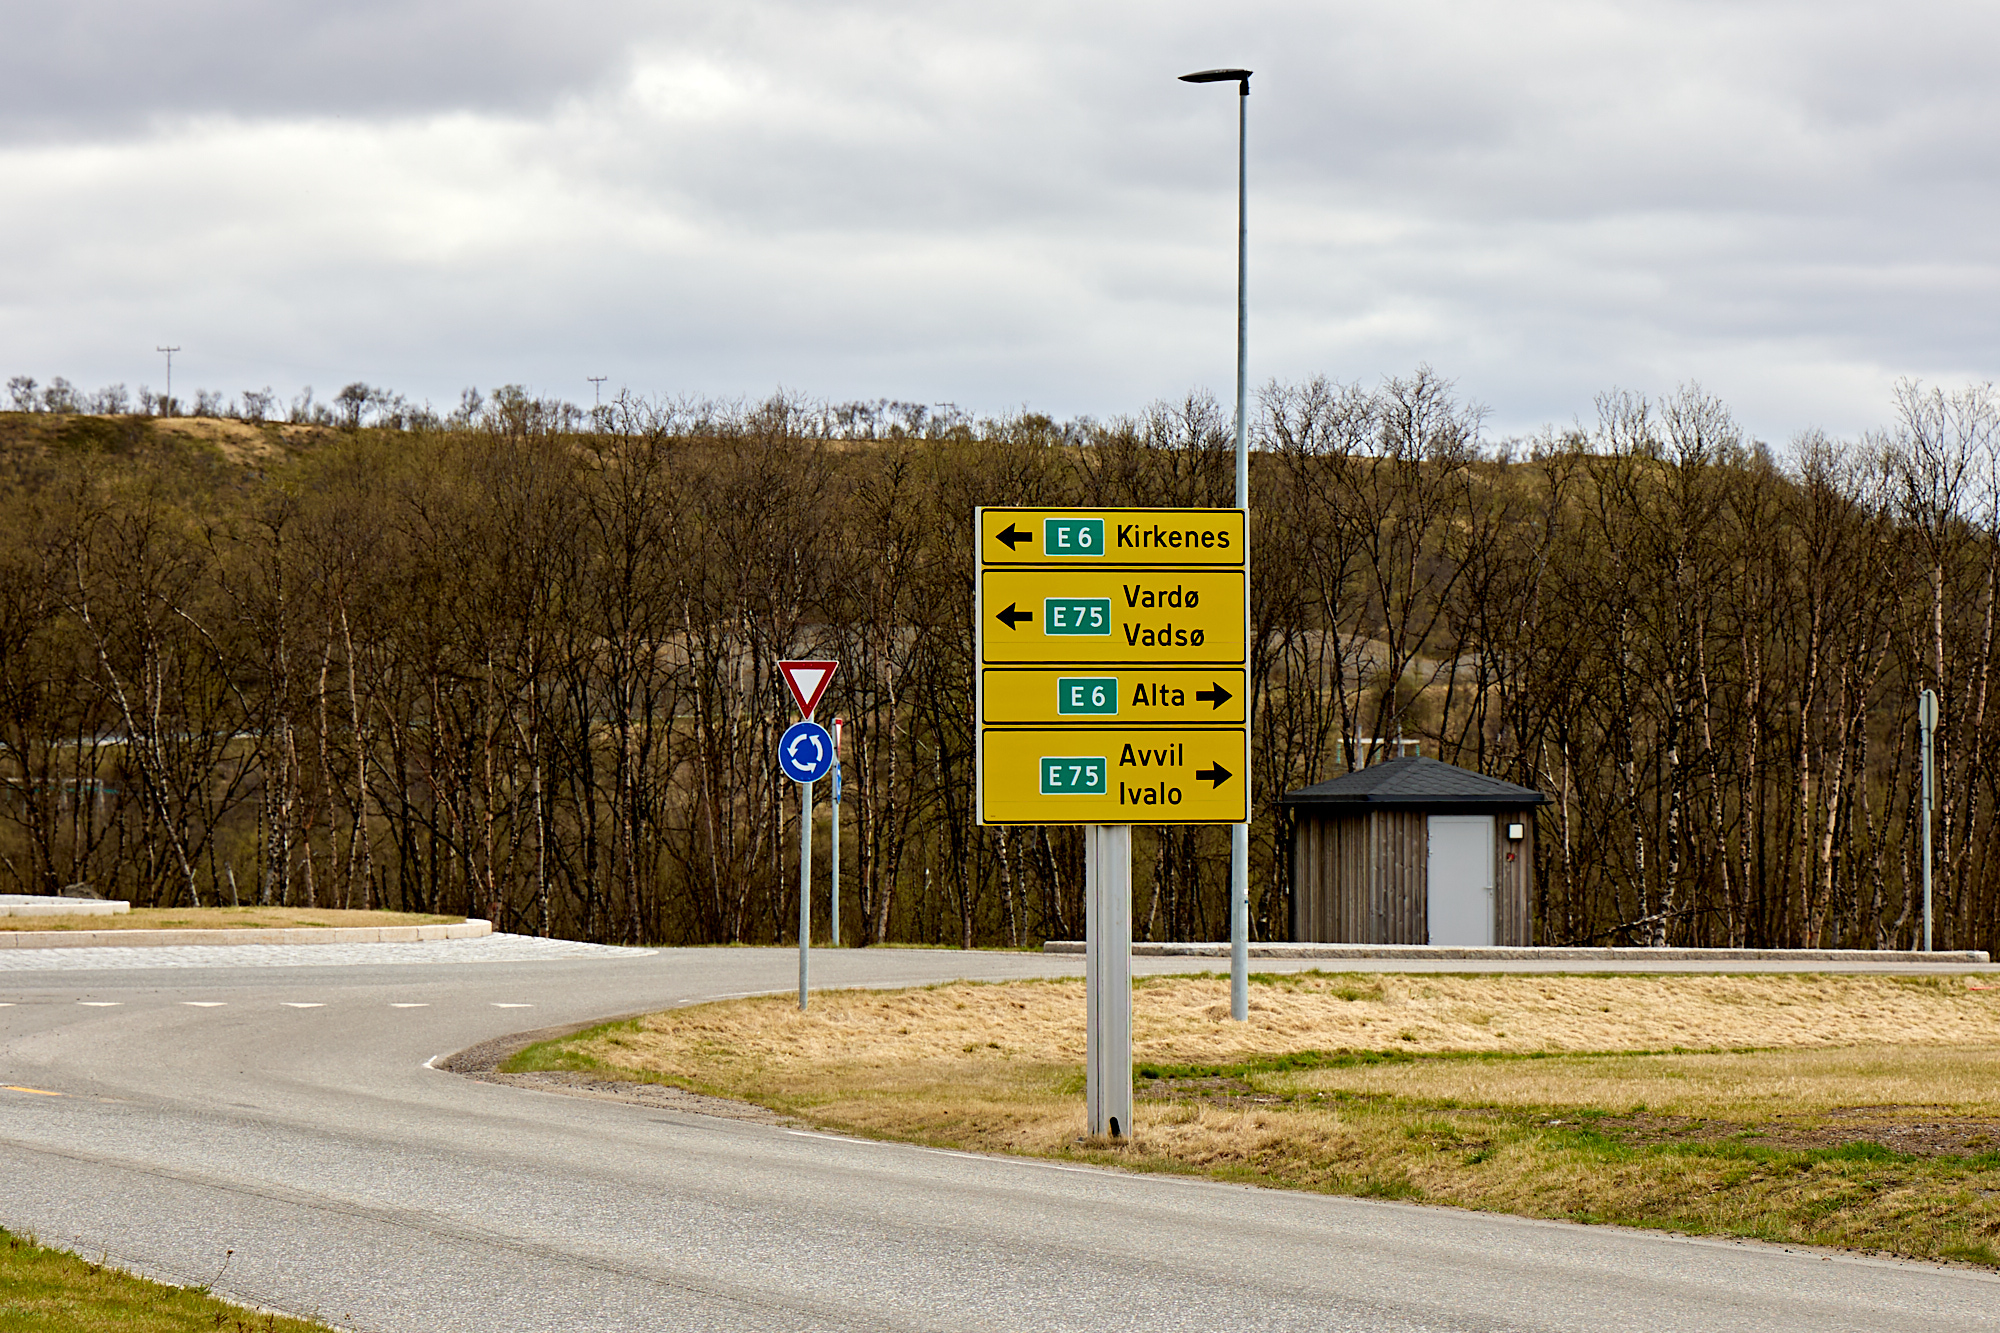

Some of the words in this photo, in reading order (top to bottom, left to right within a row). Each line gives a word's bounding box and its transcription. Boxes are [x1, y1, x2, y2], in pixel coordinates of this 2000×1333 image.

[1058, 528, 1070, 547] E
[1078, 528, 1092, 547] 6
[1117, 525, 1230, 548] Kirkenes
[1122, 585, 1199, 608] Vardø
[1054, 607, 1066, 626] E
[1073, 607, 1103, 627] 75
[1123, 624, 1205, 646] Vadsø
[1071, 687, 1084, 706] E
[1091, 686, 1106, 706] 6
[1131, 684, 1185, 706] Alta
[1119, 744, 1183, 766] Avvil
[1049, 766, 1061, 785] E
[1069, 766, 1099, 786] 75
[1120, 782, 1183, 805] Ivalo
